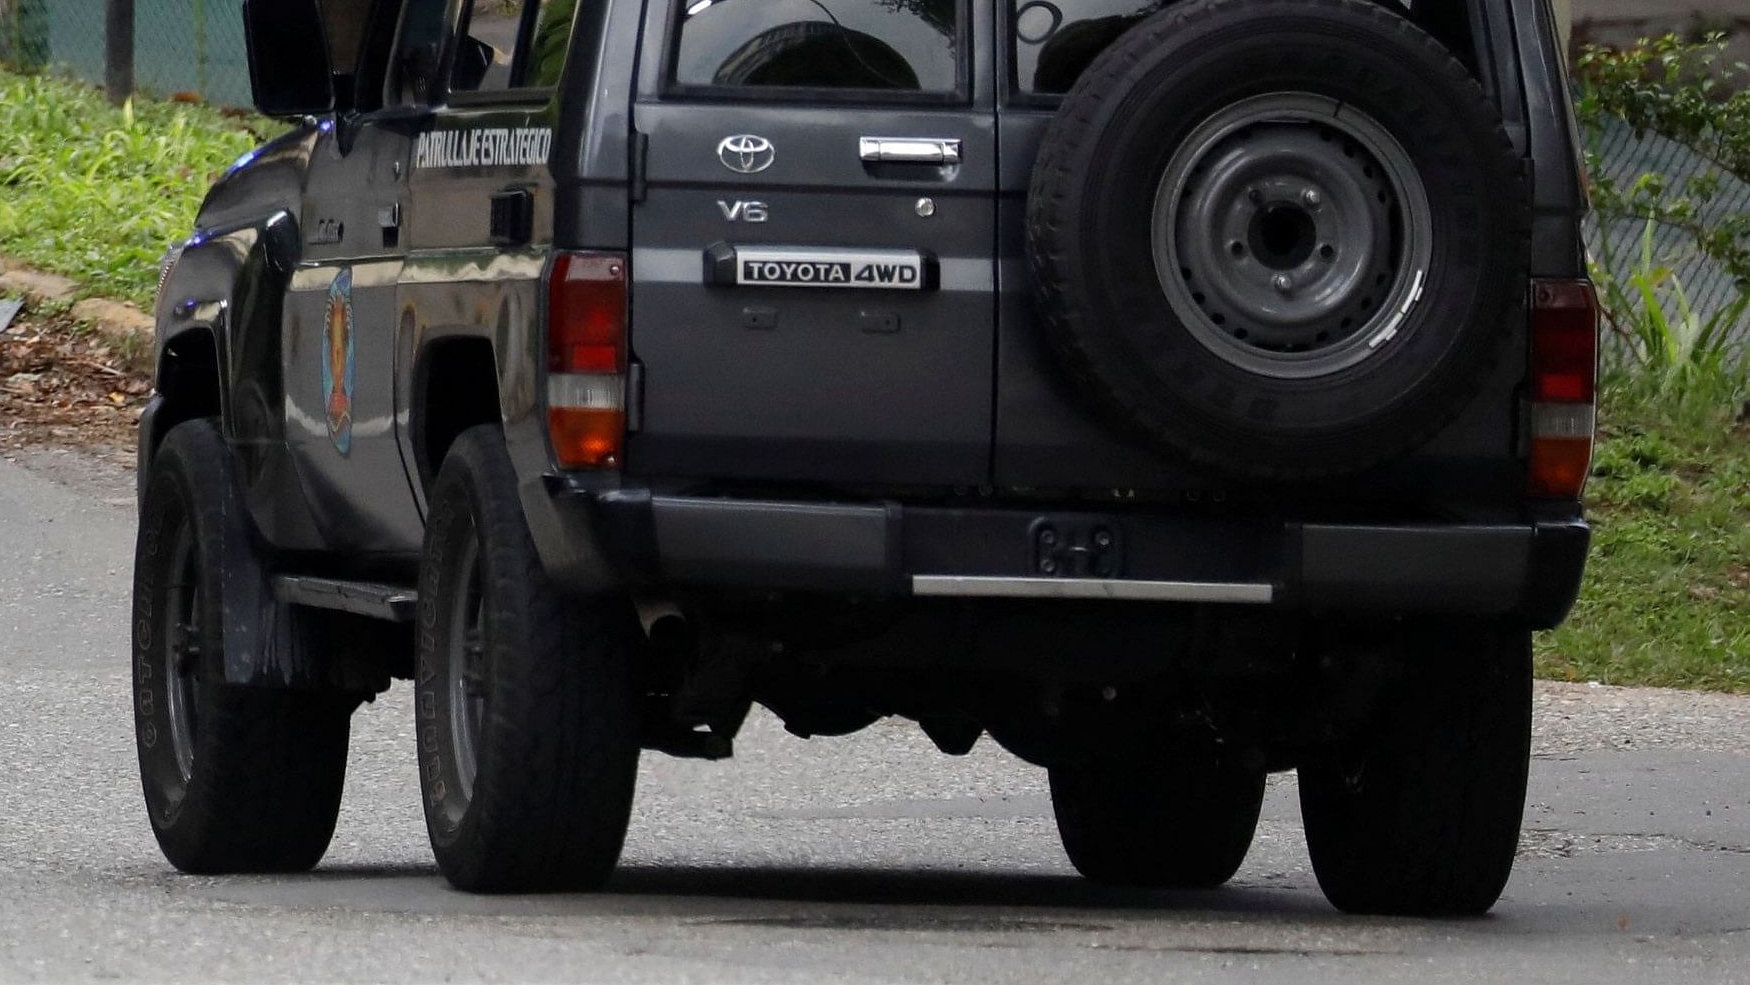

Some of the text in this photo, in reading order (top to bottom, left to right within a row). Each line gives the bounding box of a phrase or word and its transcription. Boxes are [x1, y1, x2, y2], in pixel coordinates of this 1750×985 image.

[416, 127, 552, 169] PATRULLAJE ESTRATEGICO
[717, 200, 769, 223] V6
[748, 263, 918, 284] TOYOTA 4WD
